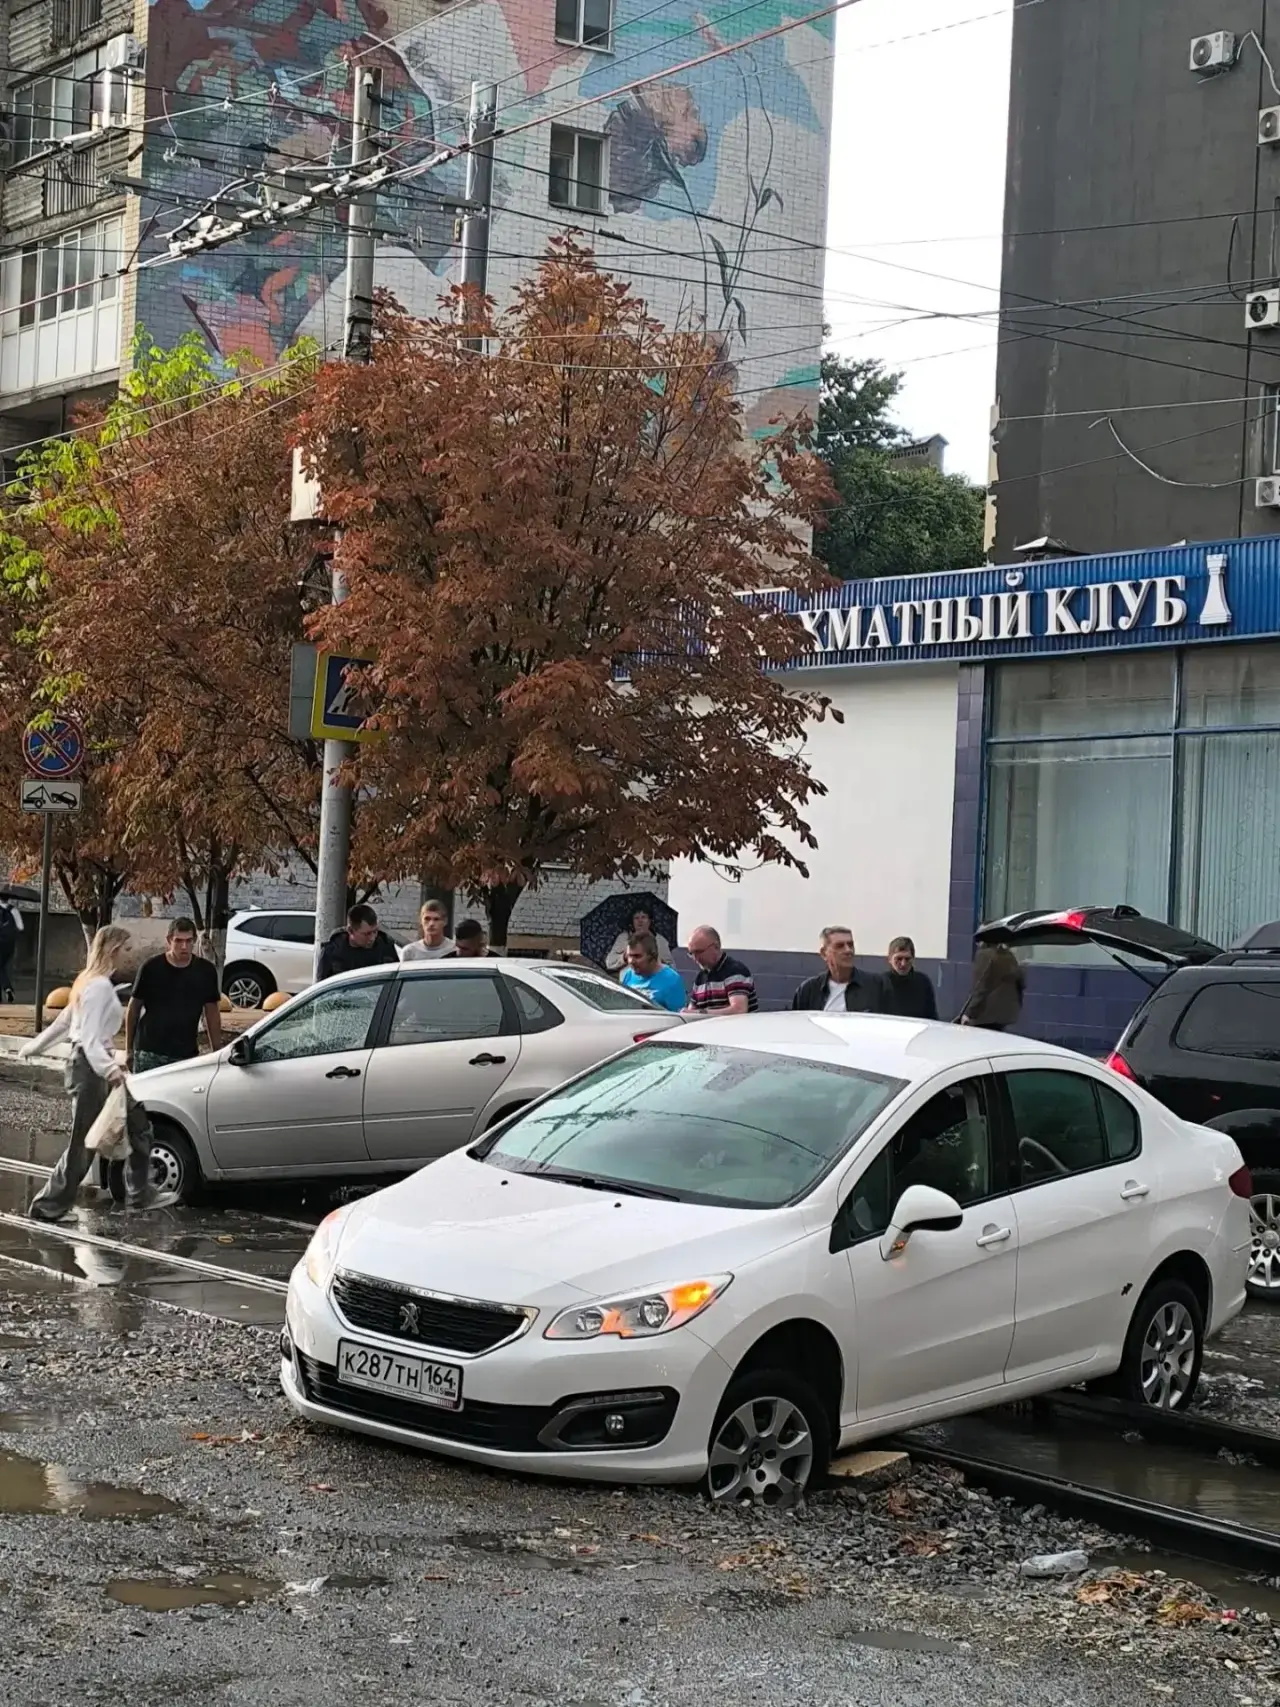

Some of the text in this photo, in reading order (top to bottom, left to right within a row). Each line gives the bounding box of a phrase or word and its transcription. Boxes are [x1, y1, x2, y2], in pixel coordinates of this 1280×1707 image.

[705, 572, 1187, 655] ХМАТНЫЙ КЛУБ
[424, 1365, 454, 1389] 164
[428, 1384, 446, 1395] RUS
